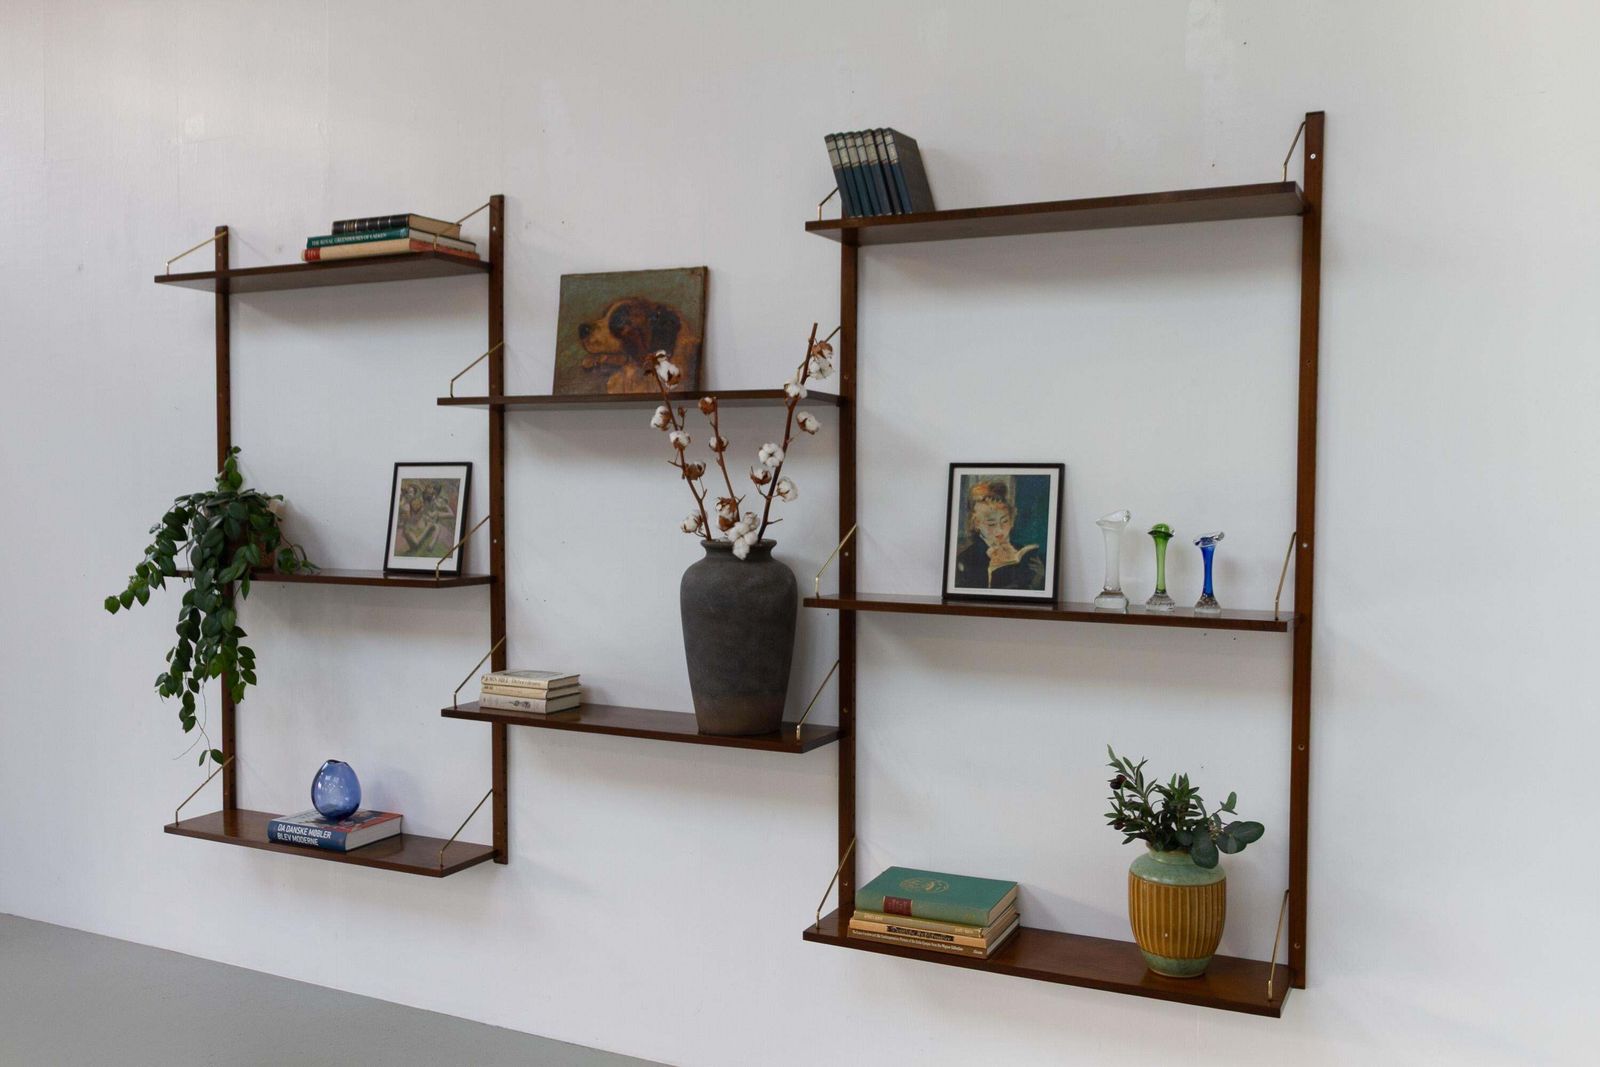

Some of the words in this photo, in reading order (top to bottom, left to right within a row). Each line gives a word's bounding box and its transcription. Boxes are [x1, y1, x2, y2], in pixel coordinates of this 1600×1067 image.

[277, 824, 286, 832] DA
[286, 825, 308, 836] DANSKE
[308, 829, 332, 840] MØBLER
[277, 832, 292, 842] BLEV
[292, 835, 319, 846] MODERNE
